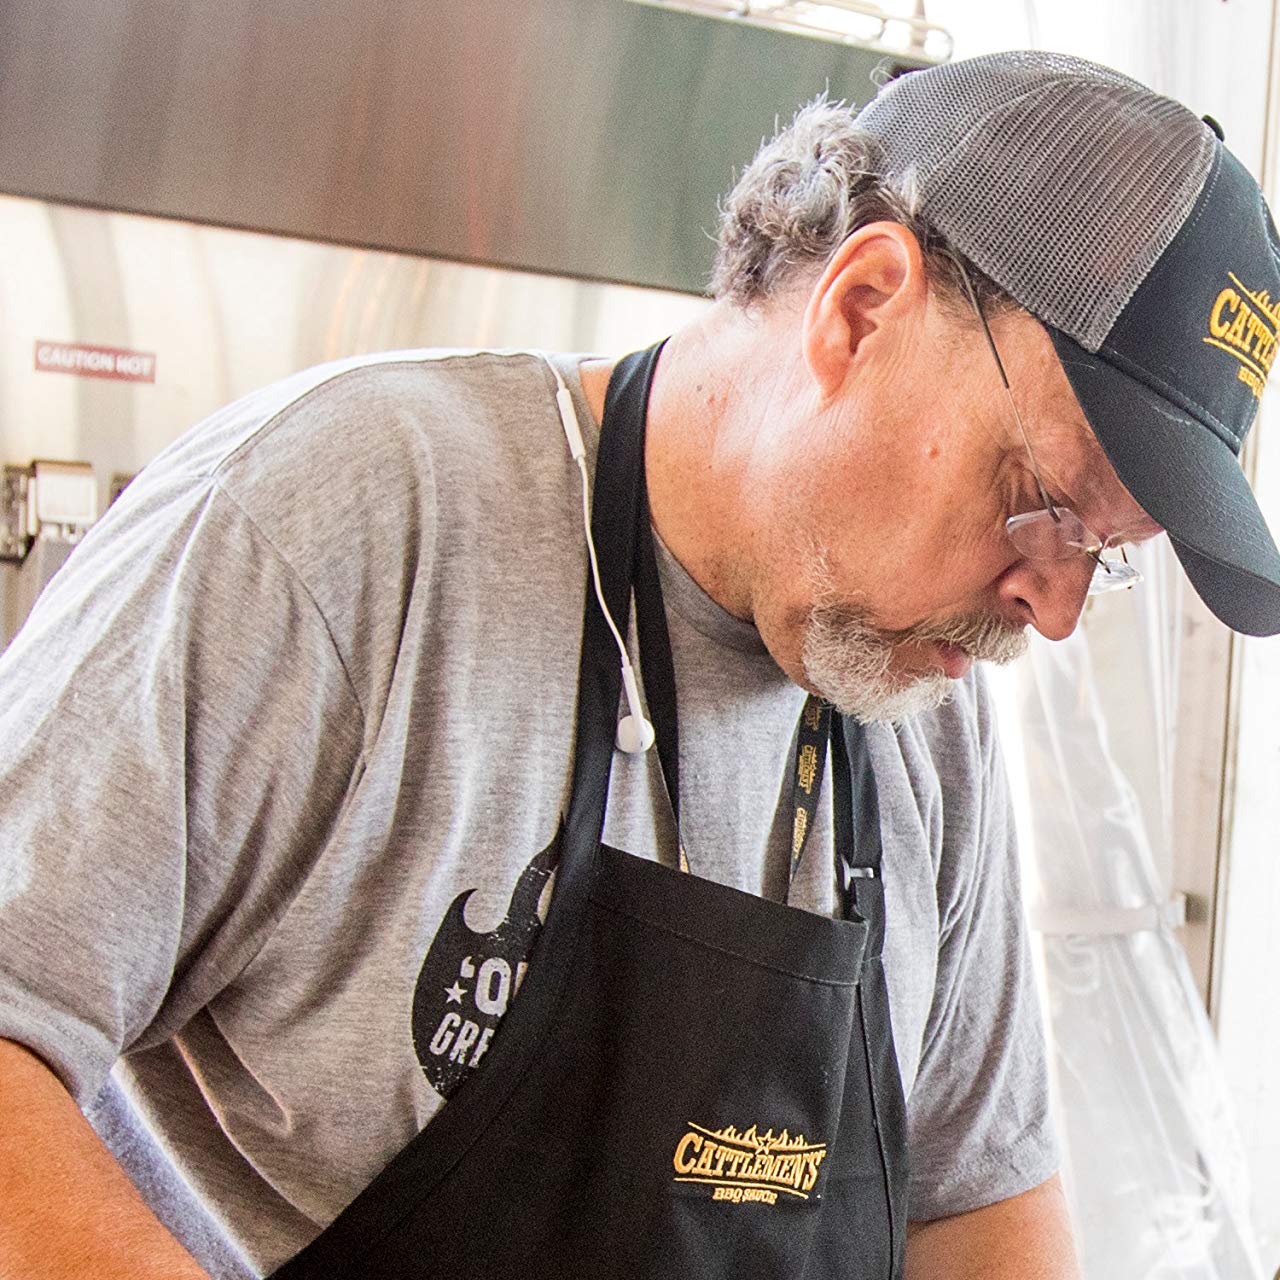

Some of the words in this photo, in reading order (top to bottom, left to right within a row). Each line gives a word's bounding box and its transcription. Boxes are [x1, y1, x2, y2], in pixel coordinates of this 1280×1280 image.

[37, 346, 114, 371] CAUTION
[116, 356, 152, 375] HOT
[673, 1132, 827, 1190] CATTLEMEN'S
[712, 1187, 743, 1203] BBQ
[743, 1189, 778, 1205] SAUCE
